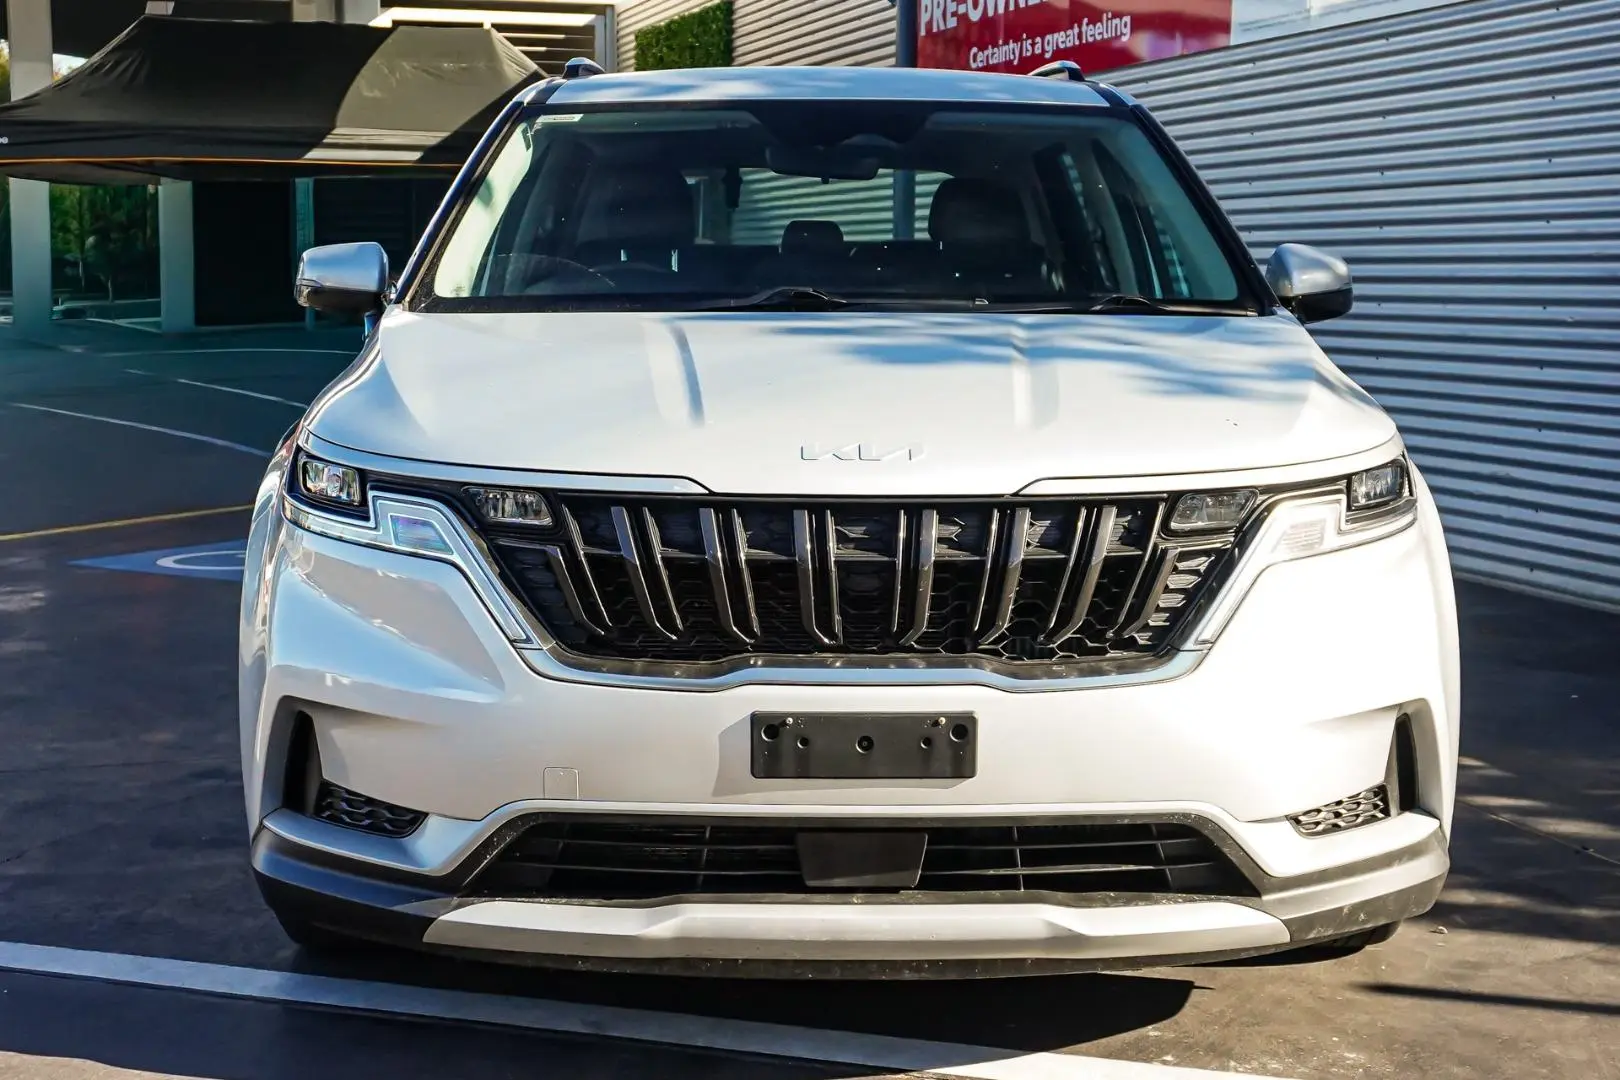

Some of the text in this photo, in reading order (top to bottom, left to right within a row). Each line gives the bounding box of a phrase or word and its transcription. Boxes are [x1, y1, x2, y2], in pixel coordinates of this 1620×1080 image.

[920, 0, 1048, 36] PRE-OW
[969, 12, 1131, 68] Certainty is a great feeling
